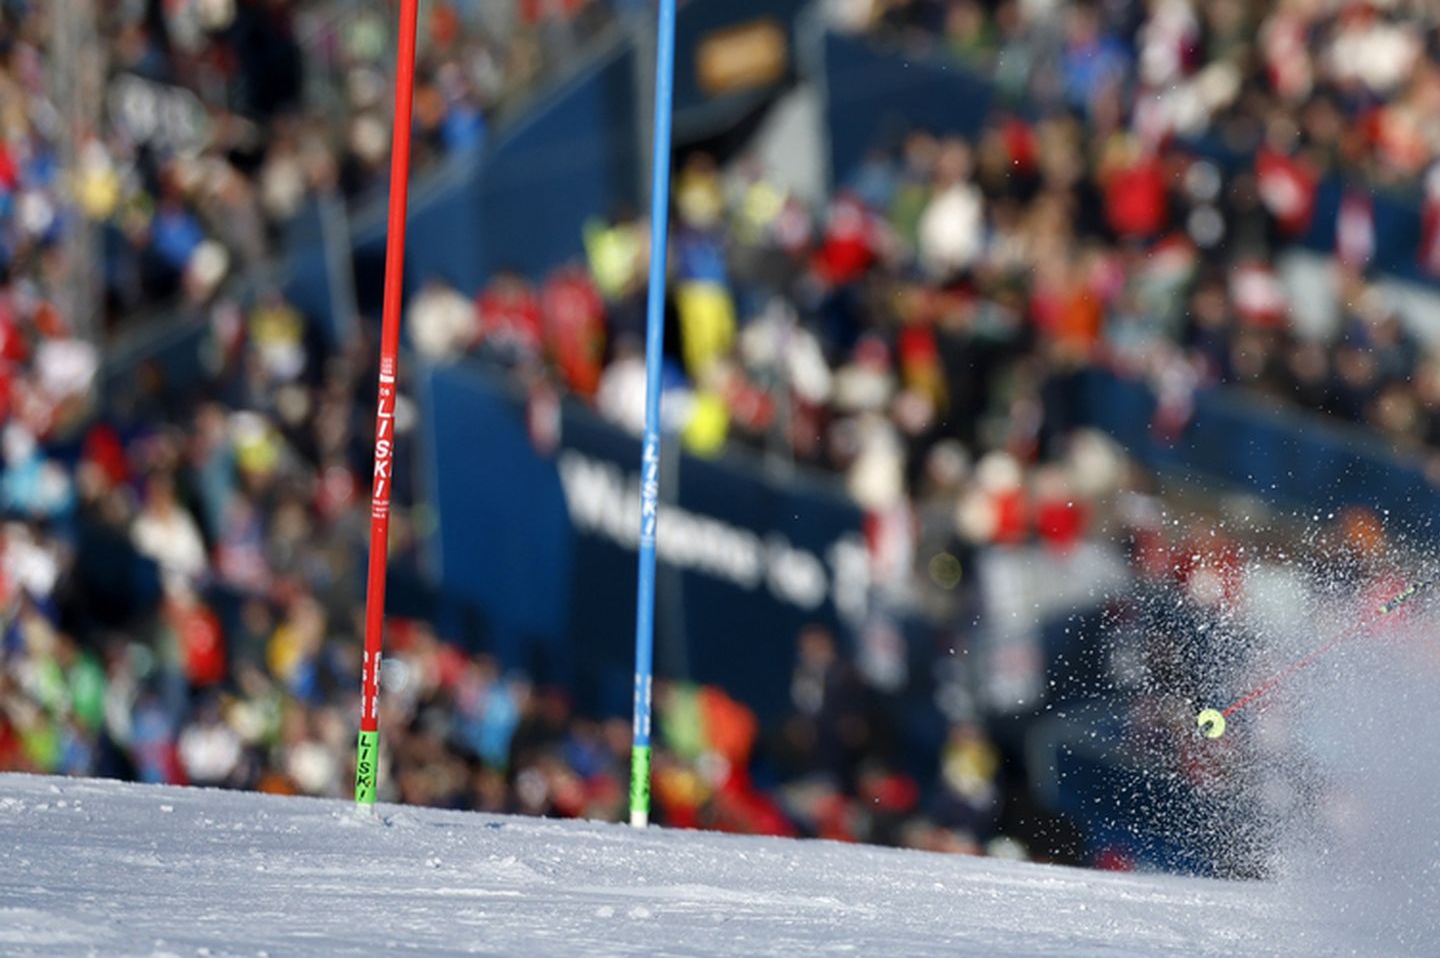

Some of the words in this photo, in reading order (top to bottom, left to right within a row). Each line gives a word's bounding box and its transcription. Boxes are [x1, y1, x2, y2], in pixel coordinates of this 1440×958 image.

[374, 398, 392, 498] LISKI
[643, 442, 658, 535] LISKI
[356, 734, 371, 800] LISKI
